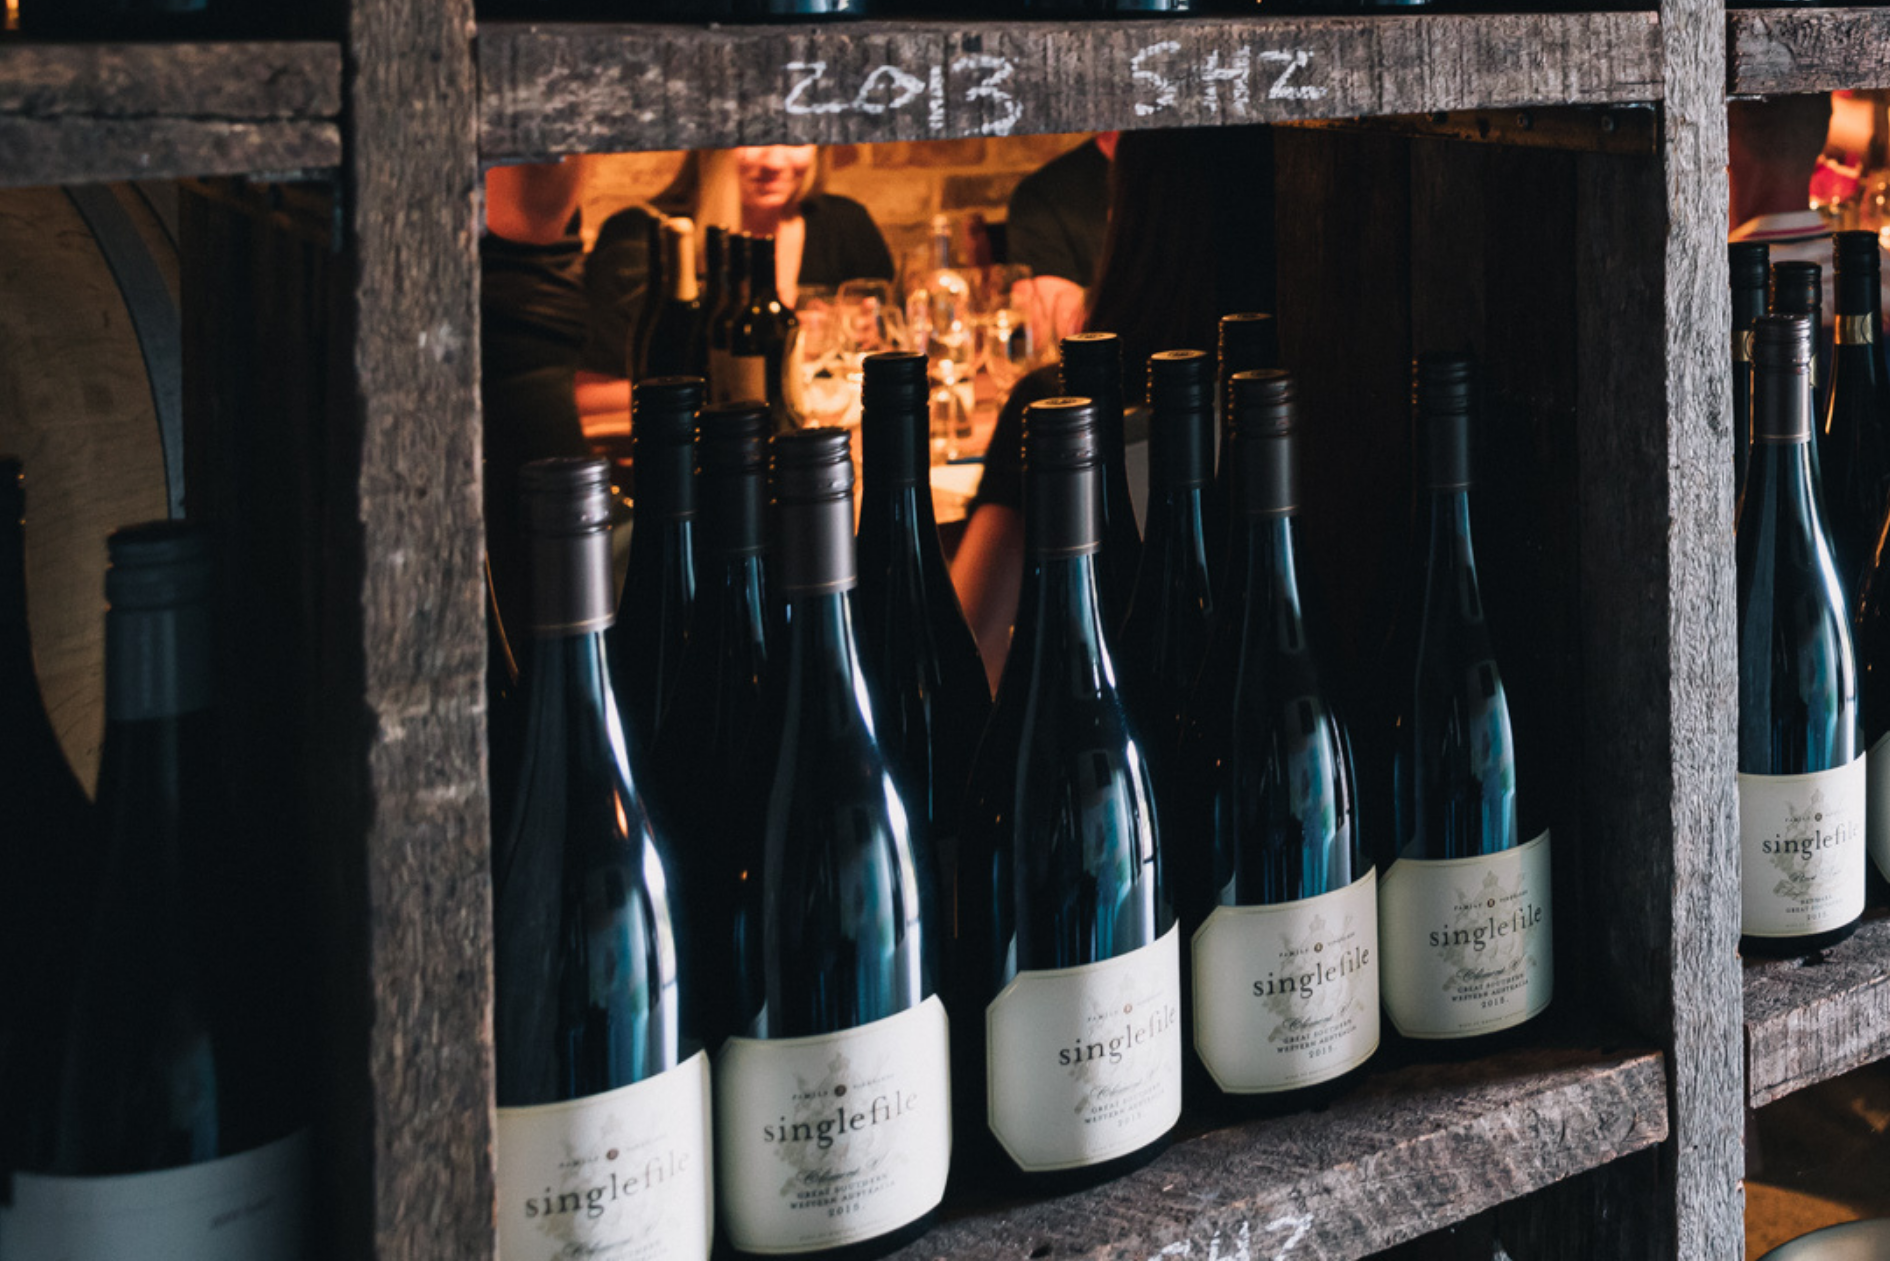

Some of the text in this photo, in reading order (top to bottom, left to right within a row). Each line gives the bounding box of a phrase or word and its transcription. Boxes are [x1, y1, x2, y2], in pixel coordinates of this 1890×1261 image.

[1130, 40, 1327, 116] SHZ
[1429, 903, 1543, 952] singlefile
[1252, 946, 1369, 999] singlefile
[1058, 1004, 1177, 1065] singlefile
[763, 1090, 919, 1150] singlefile
[525, 1150, 691, 1220] singlefile
